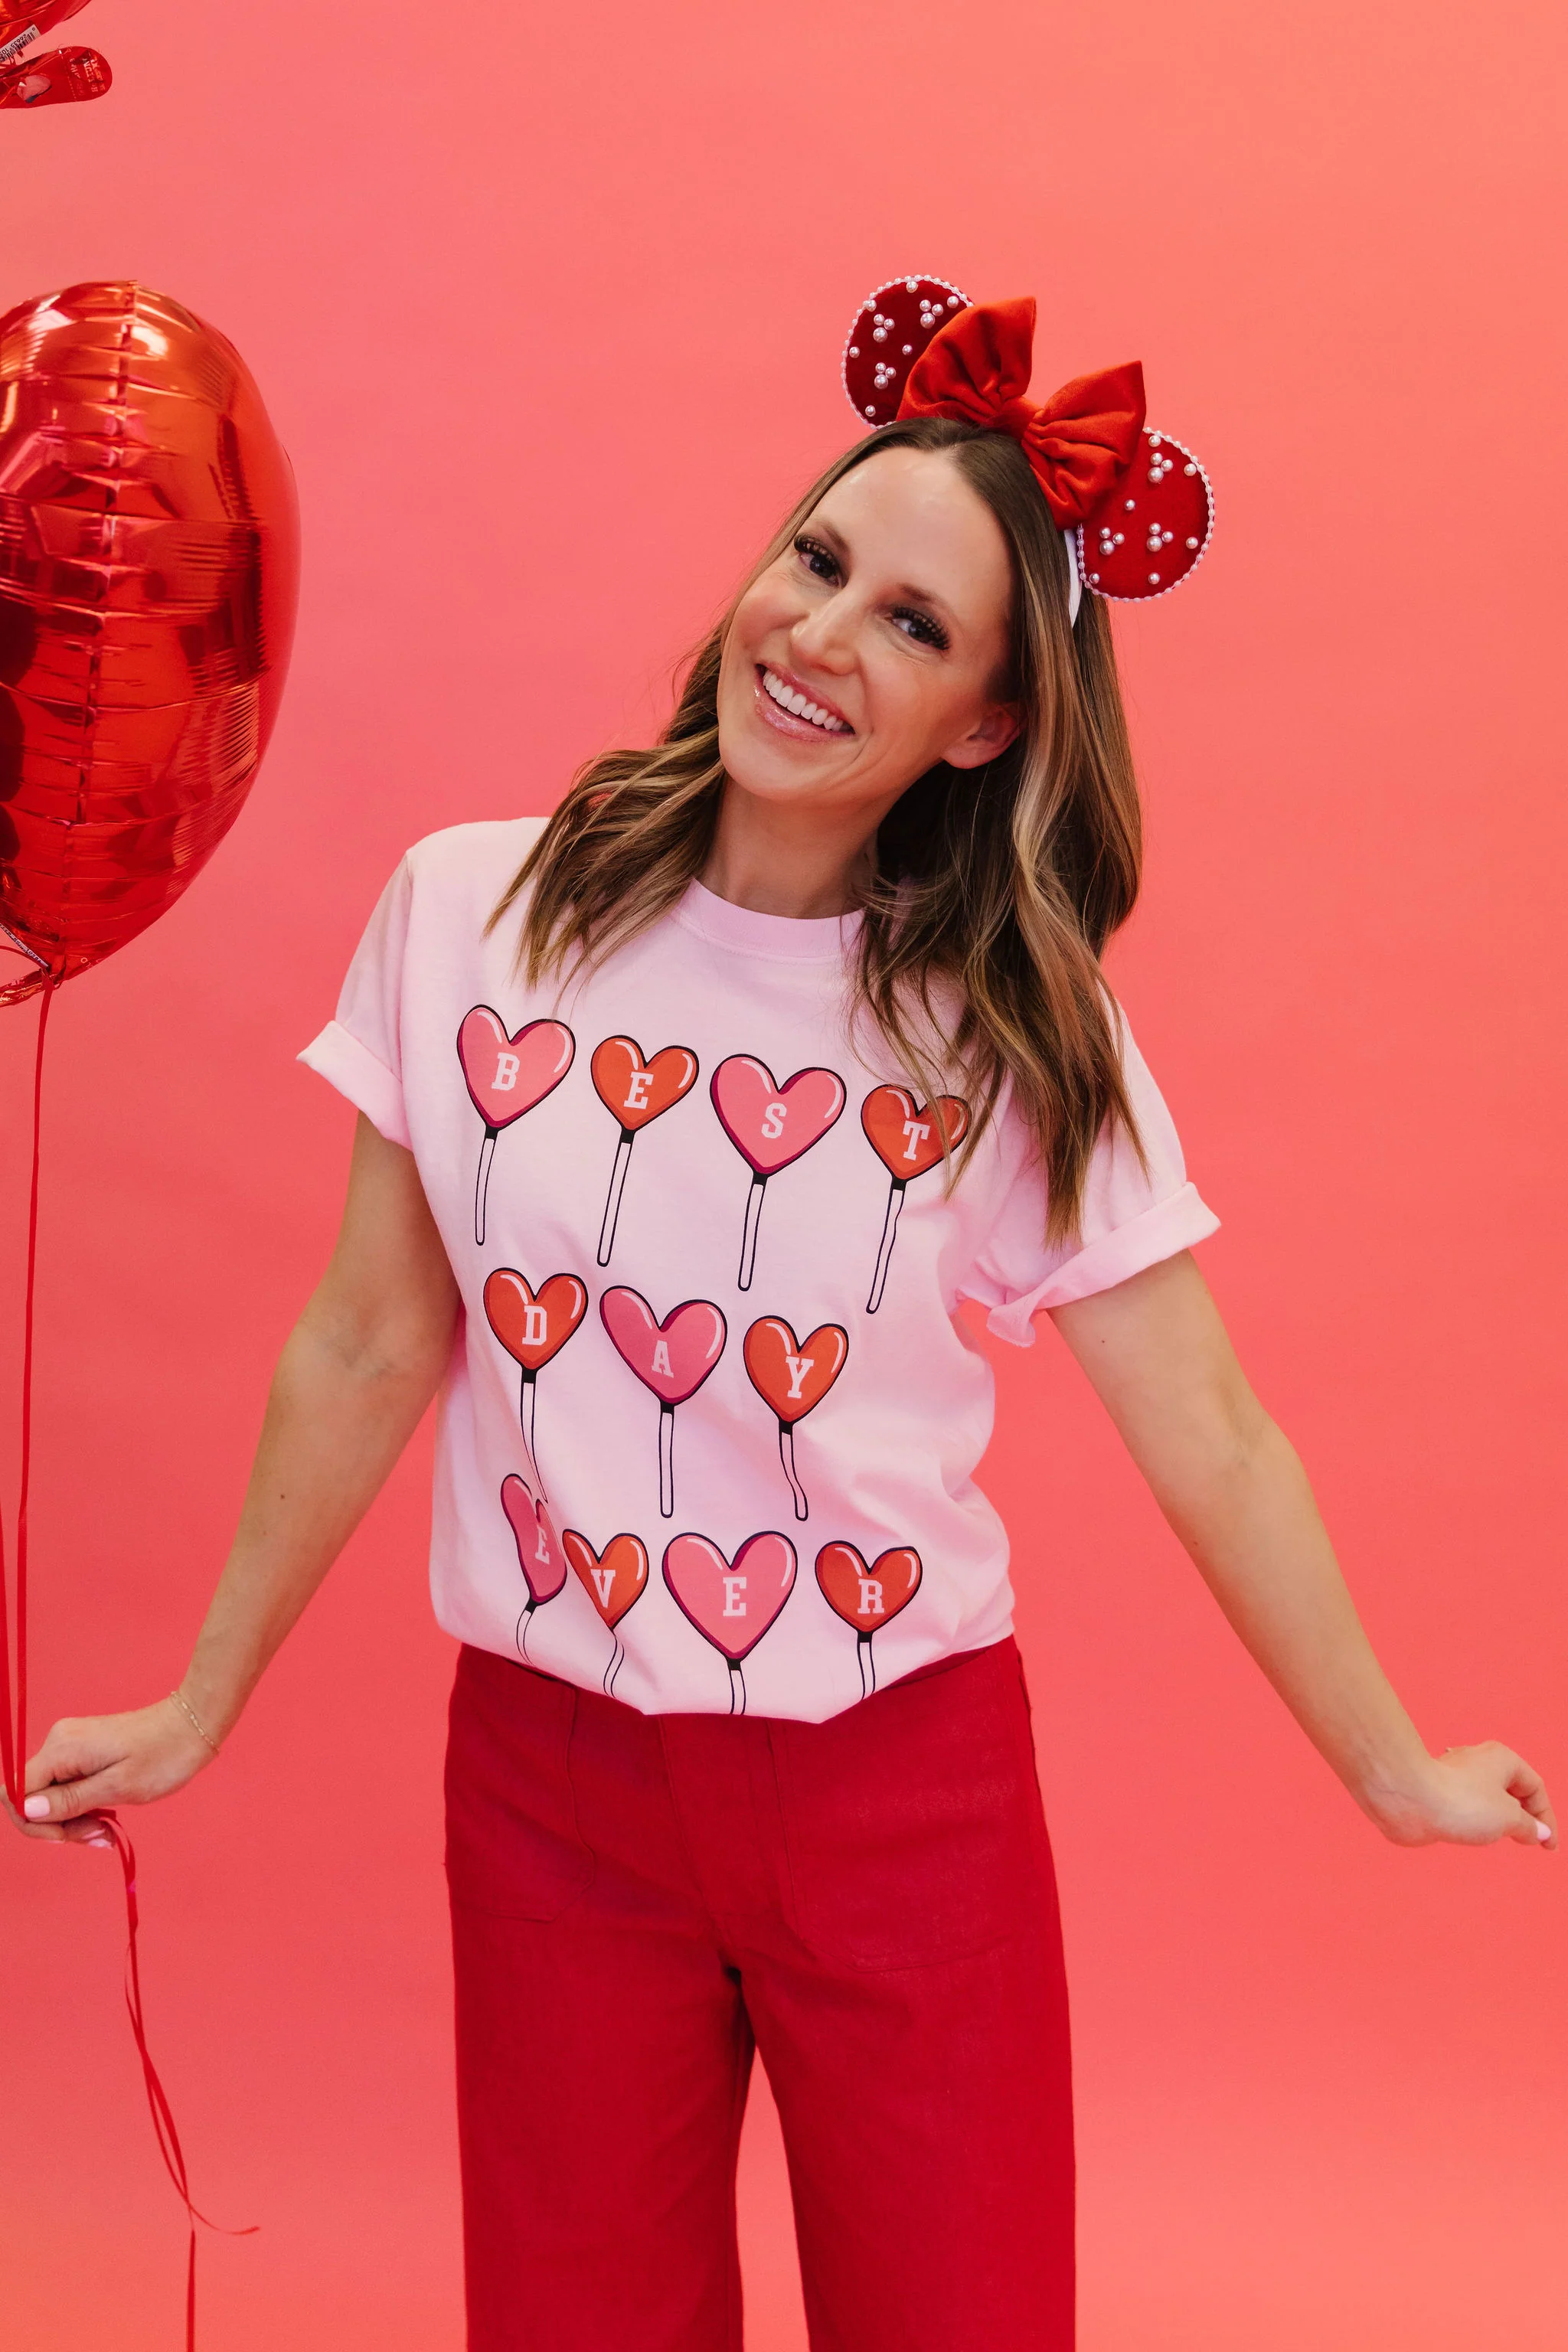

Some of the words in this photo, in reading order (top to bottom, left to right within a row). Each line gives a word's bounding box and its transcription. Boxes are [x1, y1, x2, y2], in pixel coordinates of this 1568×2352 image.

[491, 1051, 930, 1161] BEST
[521, 1305, 815, 1399] DAY
[535, 1526, 884, 1617] EVER
